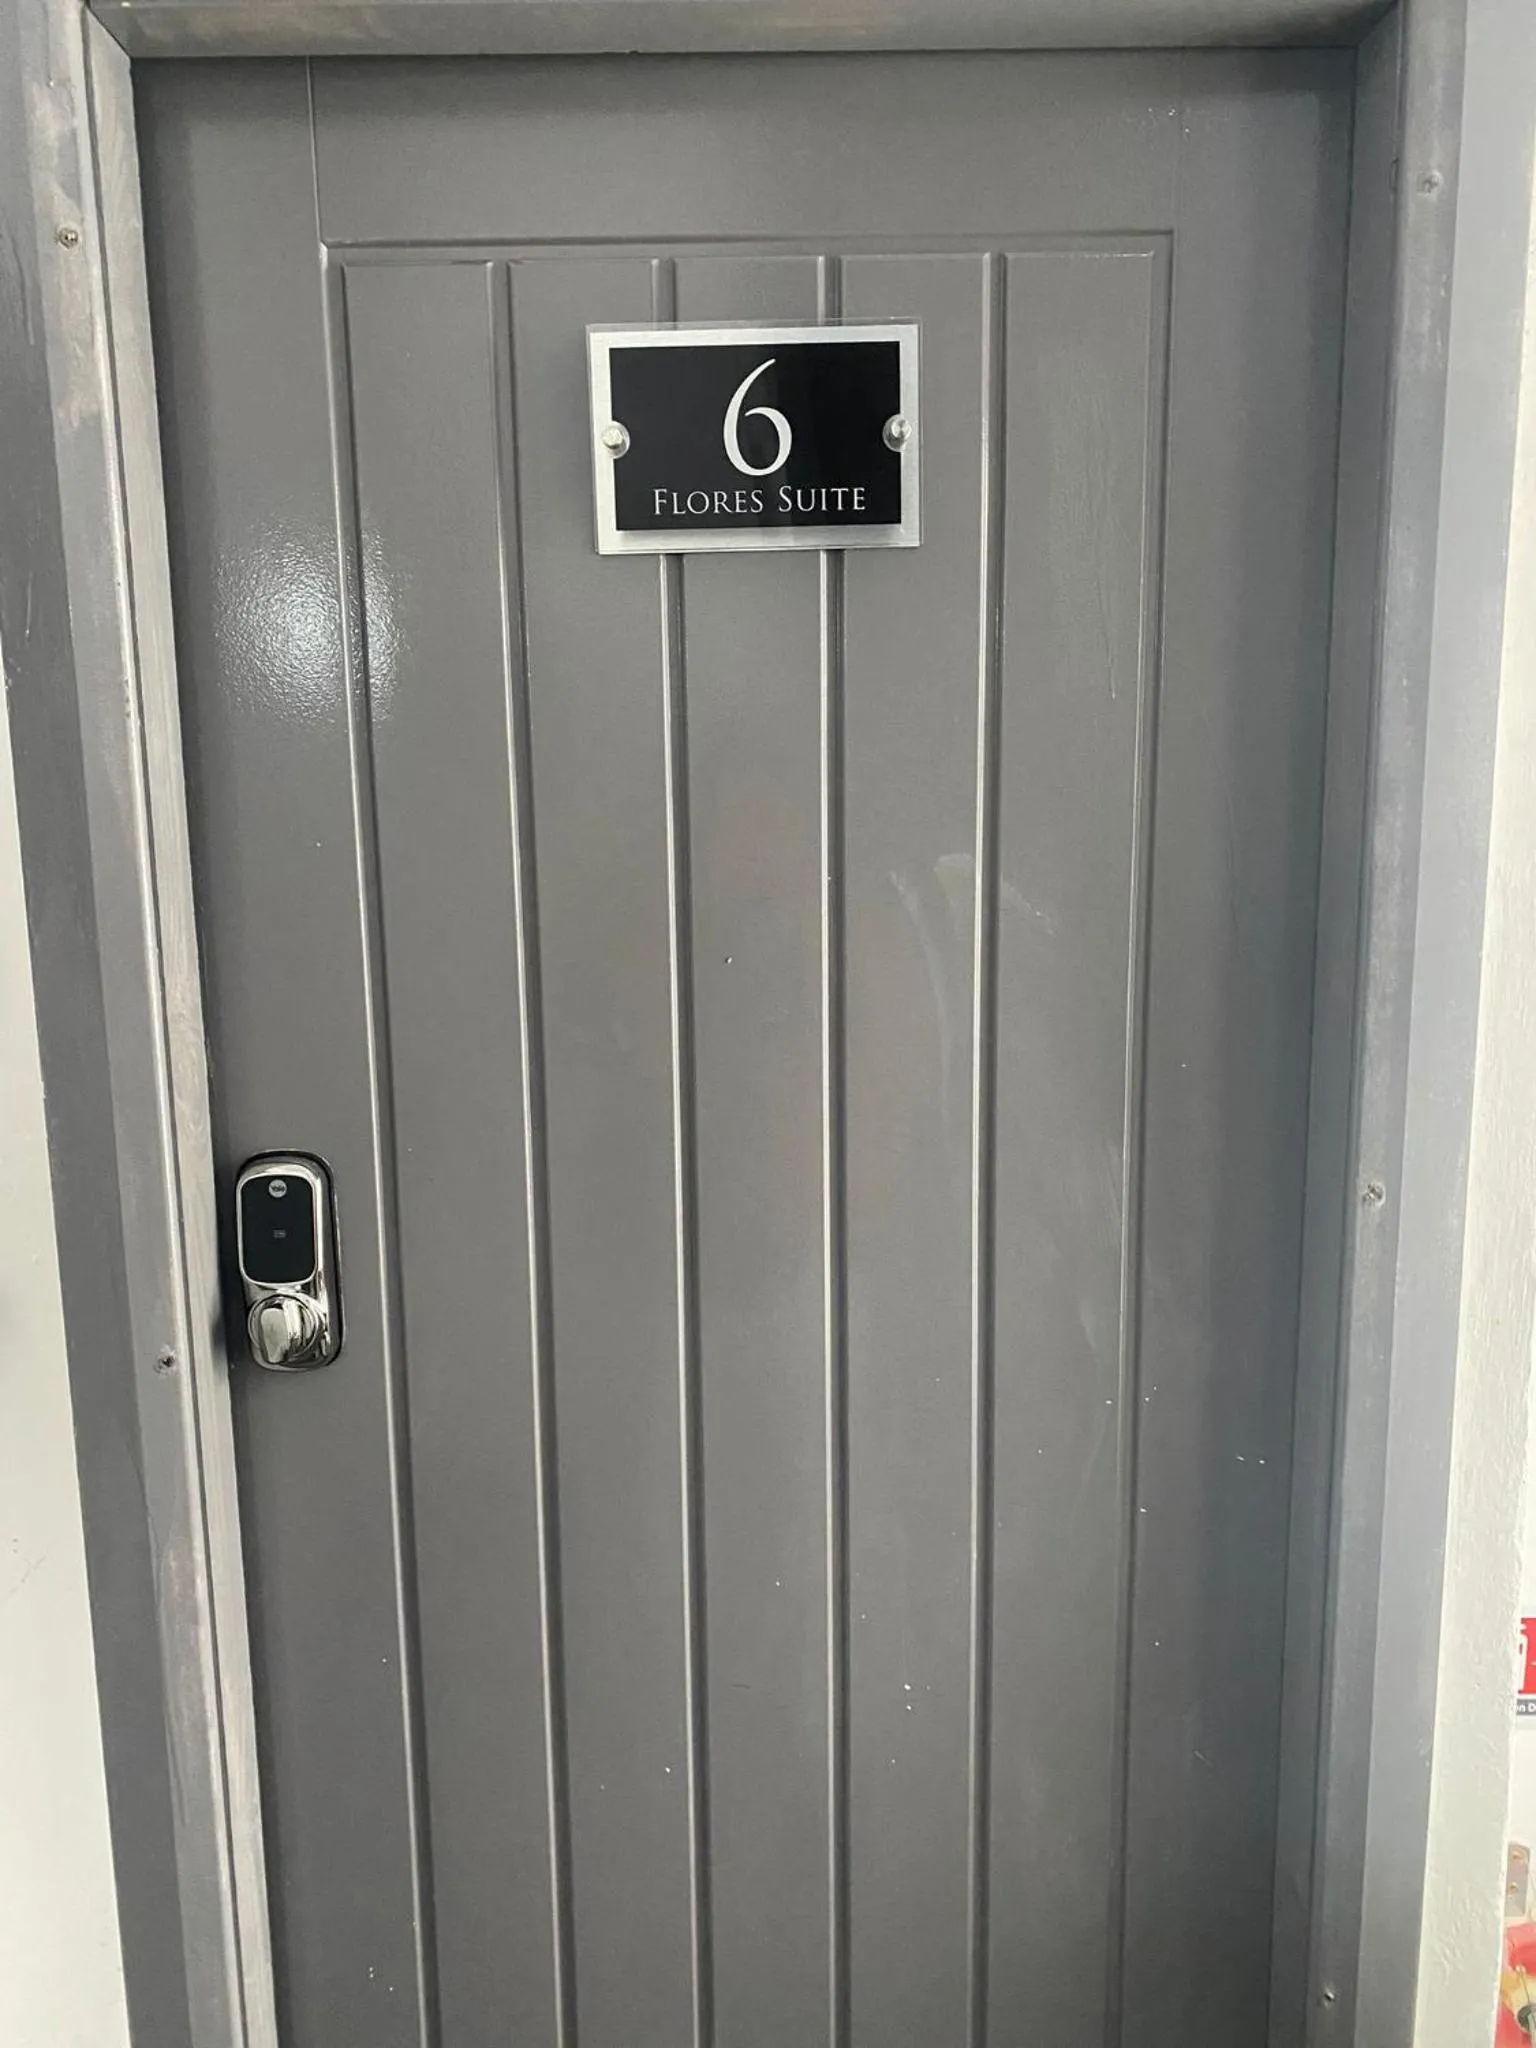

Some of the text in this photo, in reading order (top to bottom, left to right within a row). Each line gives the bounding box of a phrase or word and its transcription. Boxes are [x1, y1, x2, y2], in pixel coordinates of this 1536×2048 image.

[723, 358, 793, 476] 6
[653, 485, 866, 516] FLORES SUITE
